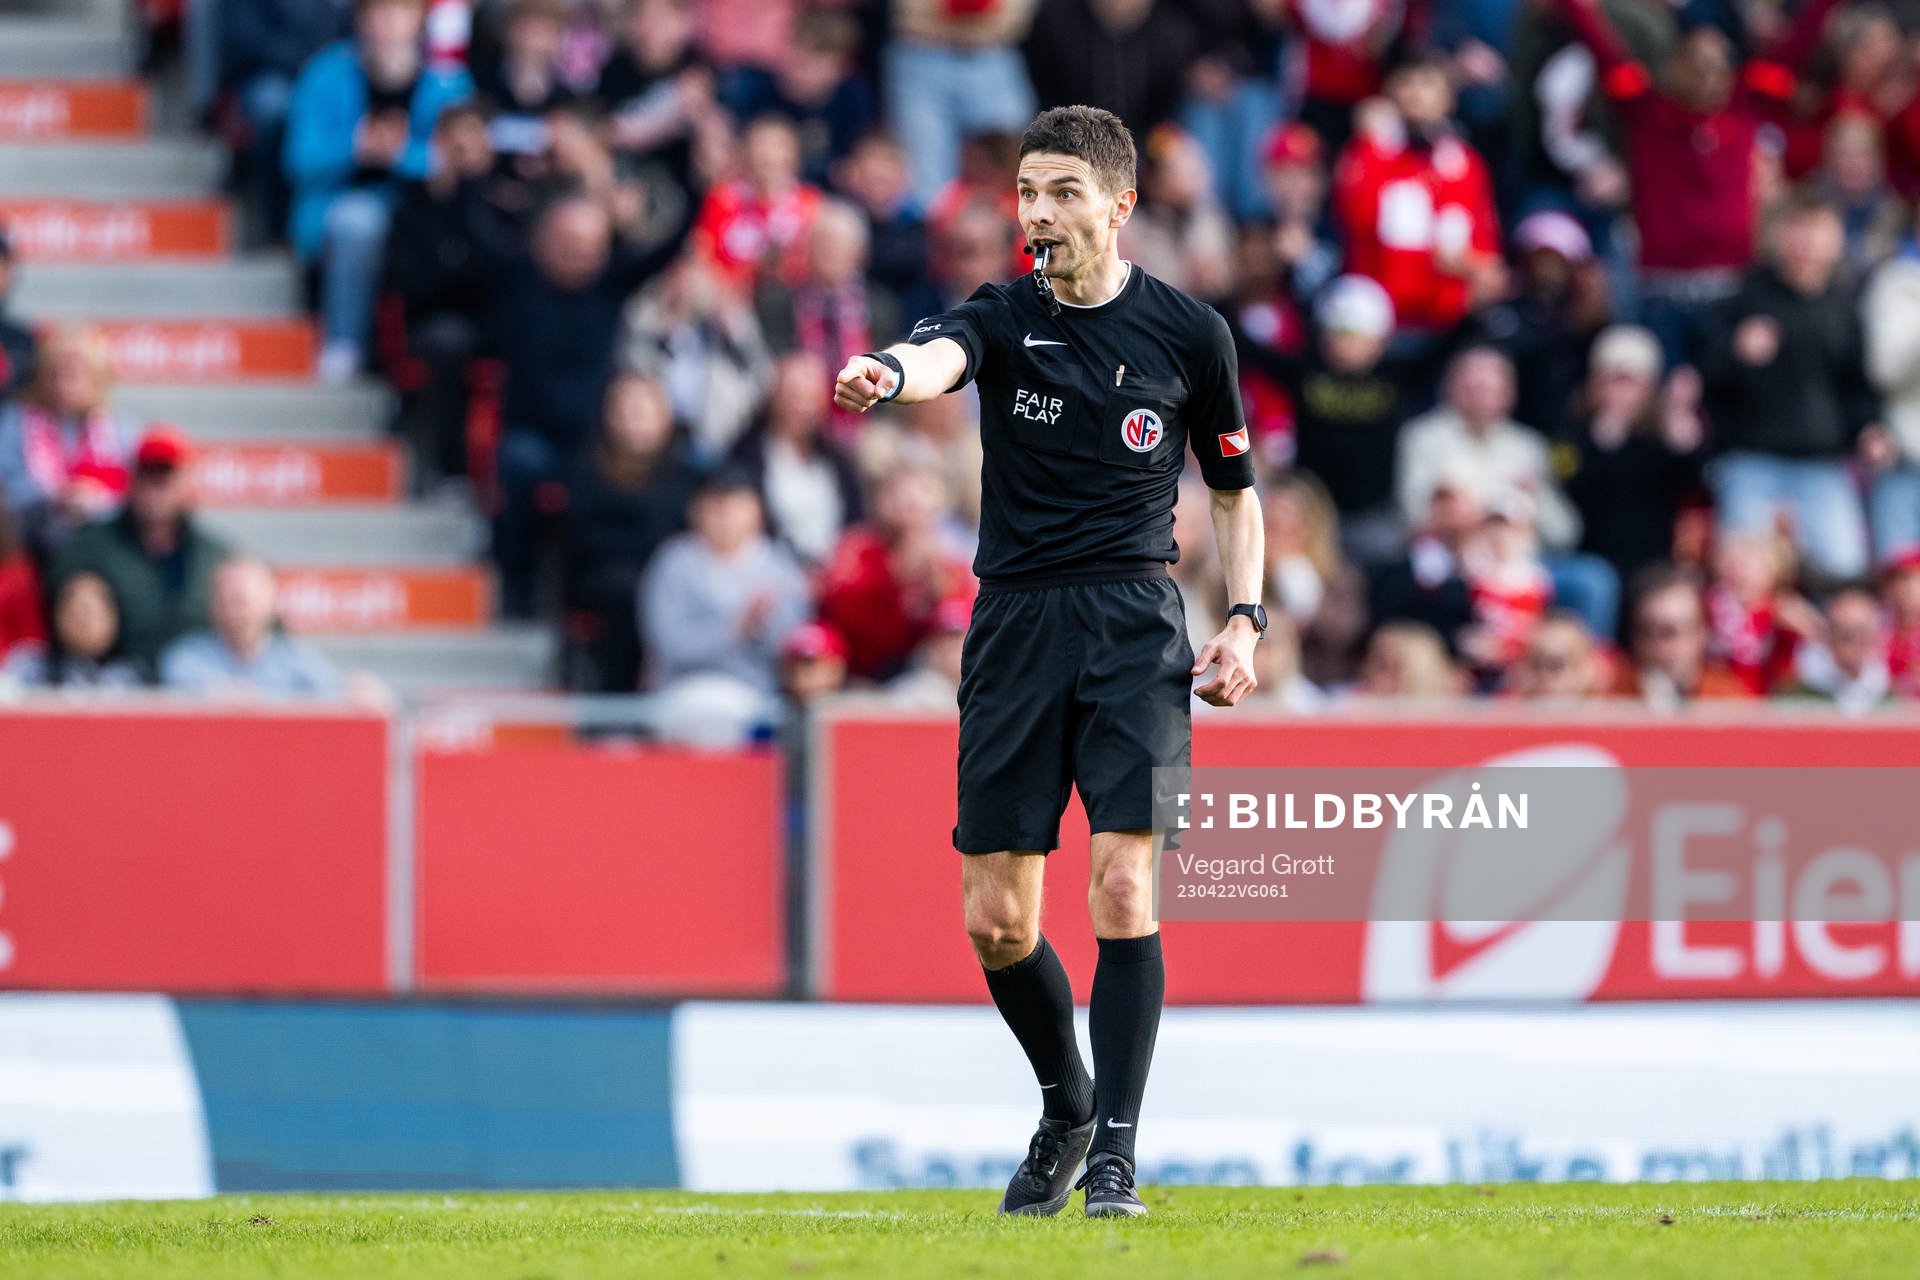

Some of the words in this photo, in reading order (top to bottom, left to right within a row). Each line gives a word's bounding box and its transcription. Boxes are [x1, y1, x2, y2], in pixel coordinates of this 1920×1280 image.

[1016, 388, 1064, 413] FAIR
[1012, 402, 1062, 425] PLAY
[1126, 414, 1158, 447] NFF
